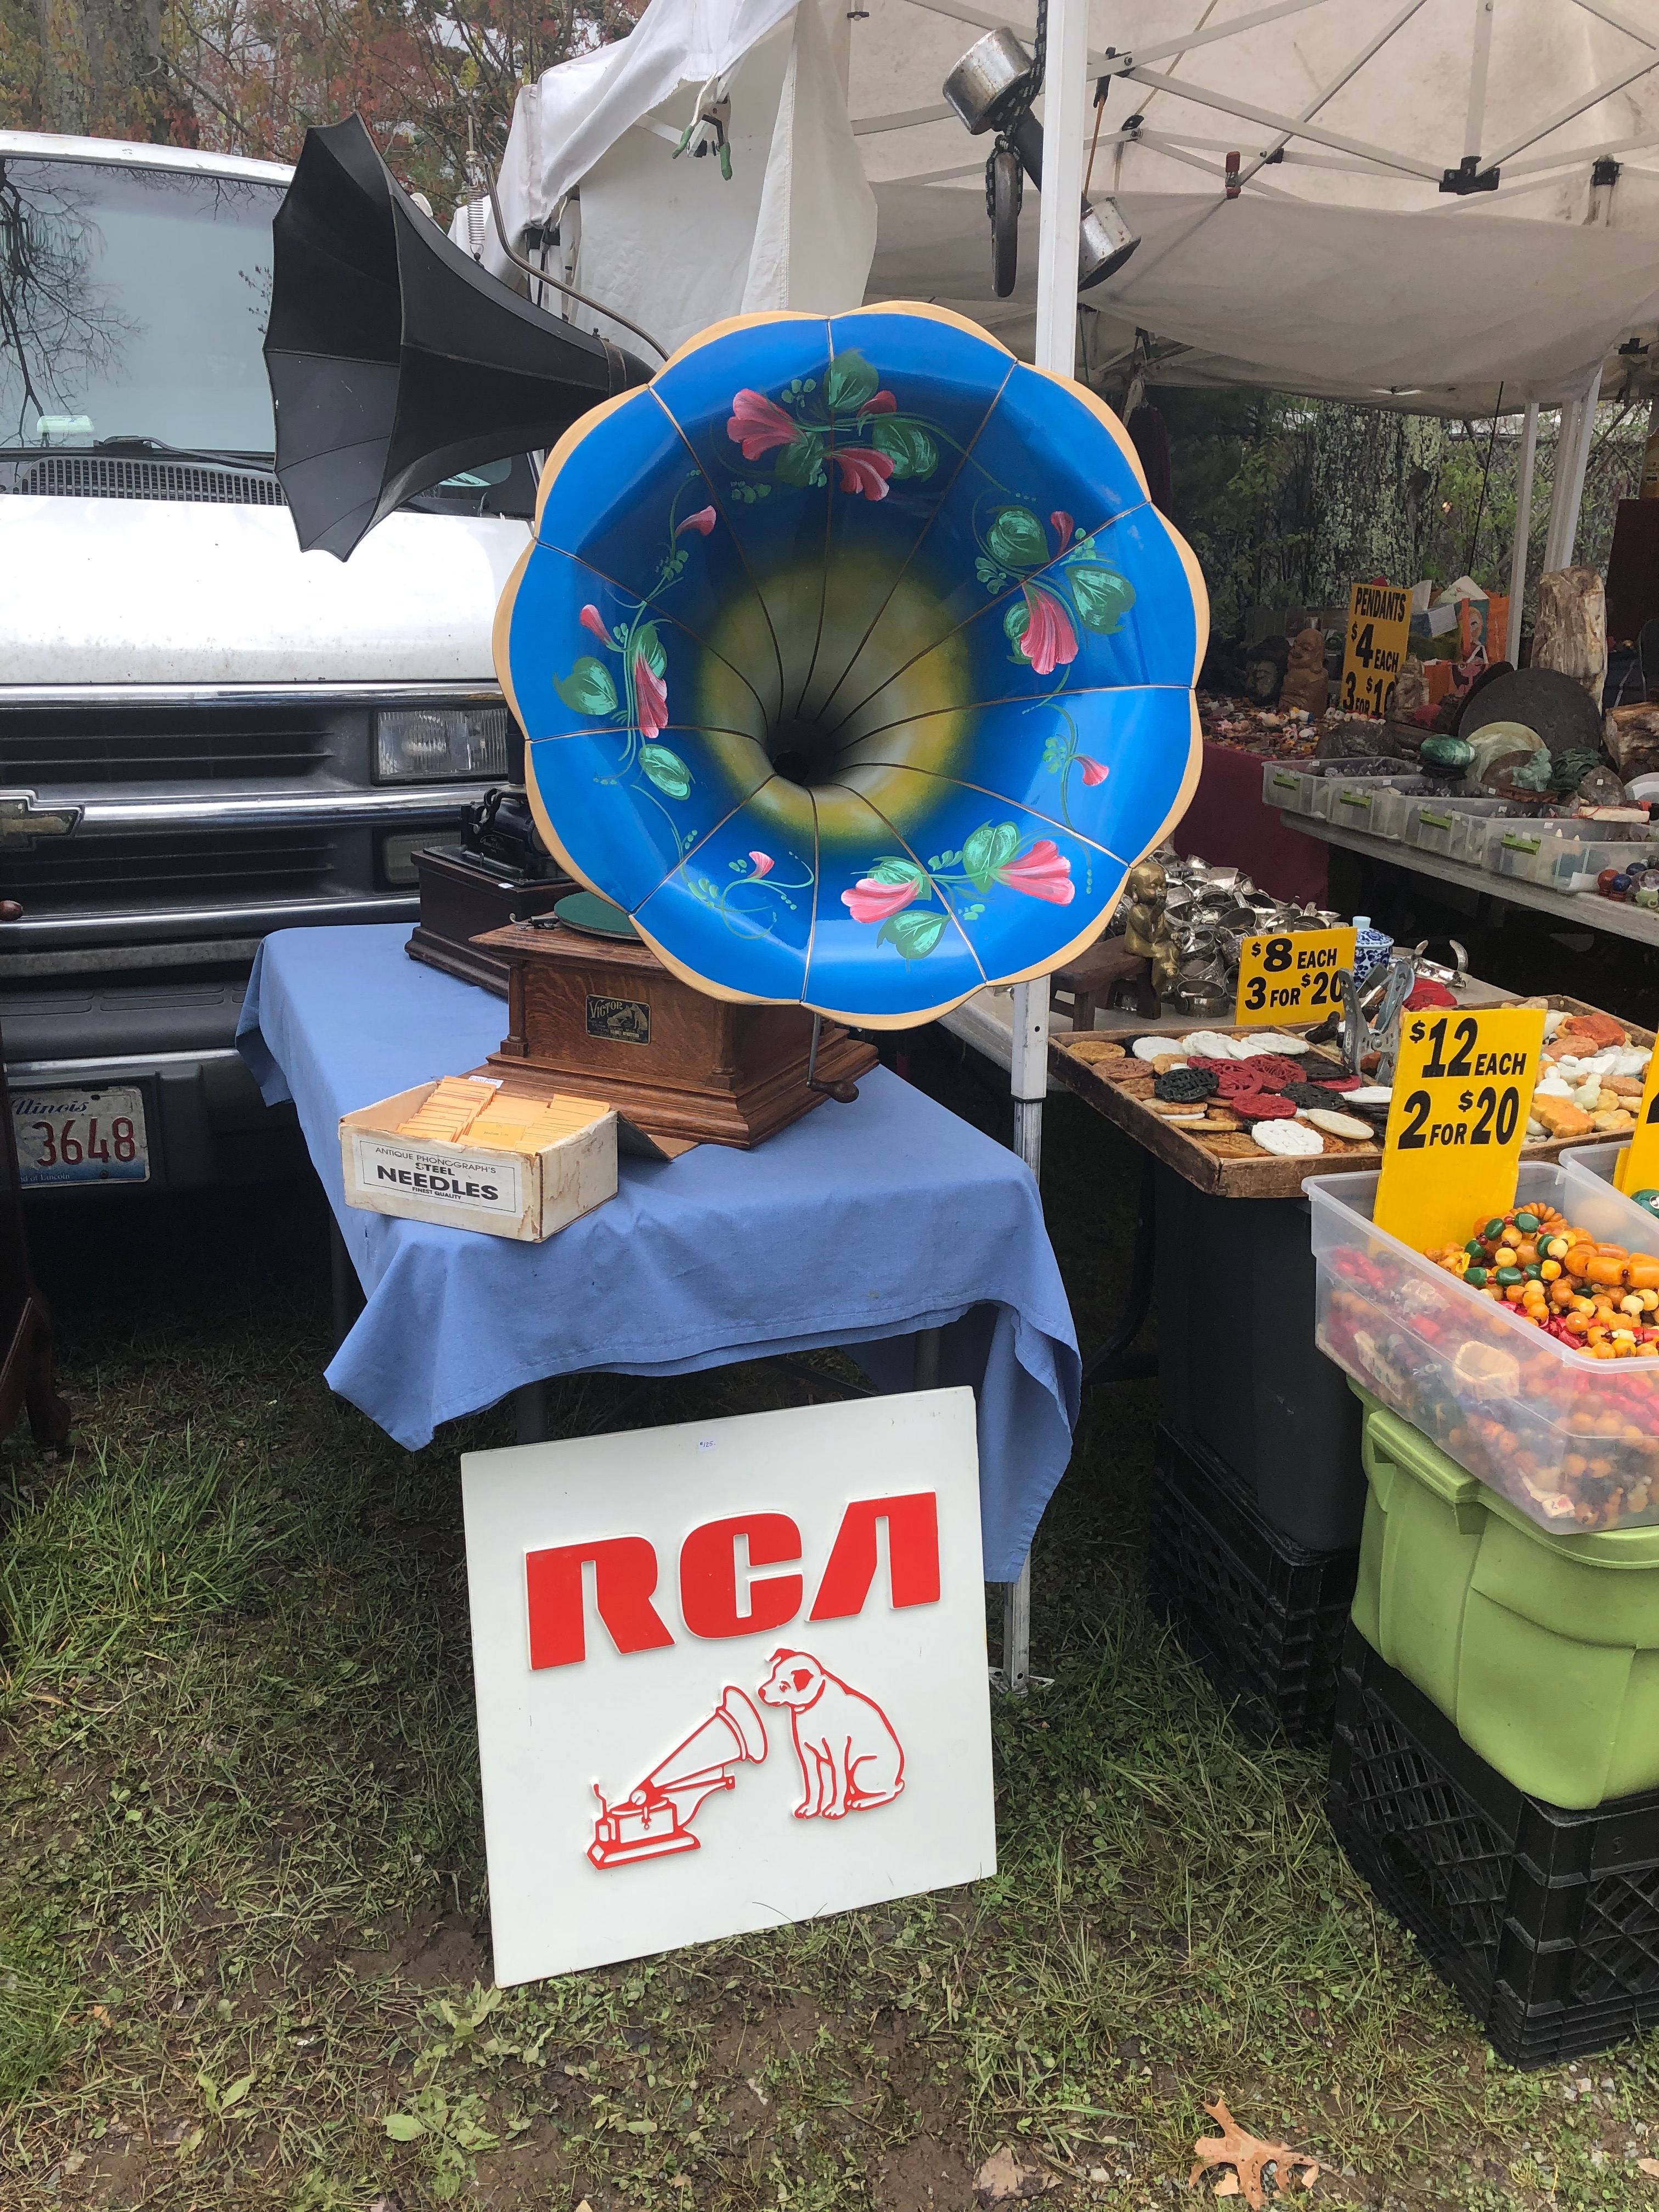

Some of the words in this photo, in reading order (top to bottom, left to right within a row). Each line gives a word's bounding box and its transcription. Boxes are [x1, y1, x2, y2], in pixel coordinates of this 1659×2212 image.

[1354, 586, 1407, 623] PENDANTS
[1351, 621, 1375, 669] $4
[1374, 648, 1400, 673] EACH
[1342, 671, 1356, 710] 3
[1355, 697, 1370, 714] FOR
[1251, 938, 1293, 973] $8
[1297, 947, 1338, 969] EACH
[588, 999, 623, 1018] VICTOR
[1244, 976, 1266, 1010] 3
[1269, 987, 1301, 1007] FOR
[1300, 971, 1342, 1005] $20
[1409, 1017, 1479, 1079] $12
[1474, 1052, 1527, 1076] EACH
[13, 1099, 89, 1115] llinois
[1397, 1090, 1432, 1150] 2
[1429, 1123, 1468, 1147] FOR
[1458, 1086, 1520, 1146] $20
[31, 1116, 136, 1167] 3648
[40, 1173, 70, 1181] Lincoln
[375, 1147, 414, 1160] ANTIQUE
[416, 1155, 496, 1174] PHONOGRAPH'S
[415, 1162, 455, 1176] STEEL
[377, 1165, 499, 1200] NEEDLES
[434, 1190, 461, 1200] QUALITY
[525, 1491, 940, 1671] RCA
